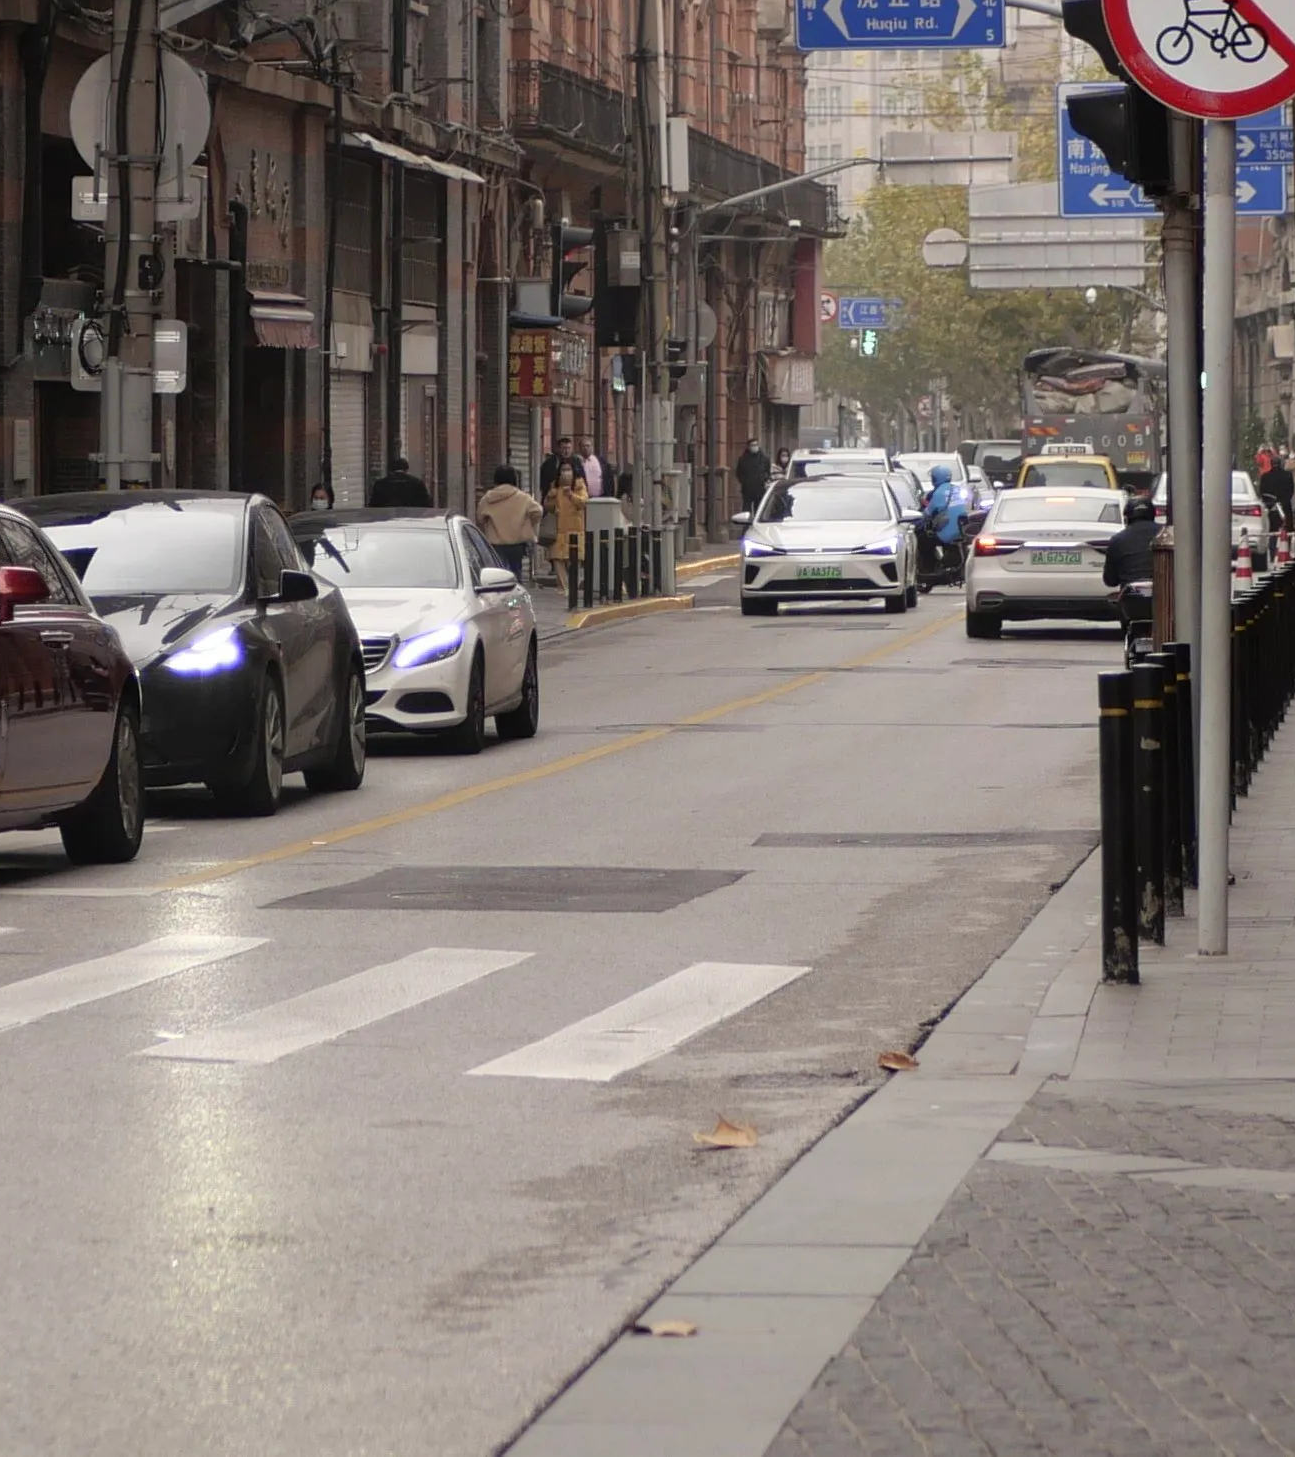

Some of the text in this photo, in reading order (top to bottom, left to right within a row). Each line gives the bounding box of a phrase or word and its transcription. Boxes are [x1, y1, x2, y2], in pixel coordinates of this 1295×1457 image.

[866, 16, 939, 33] Huqiu Rd.
[986, 29, 995, 42] 5
[1069, 162, 1111, 177] Nanjing
